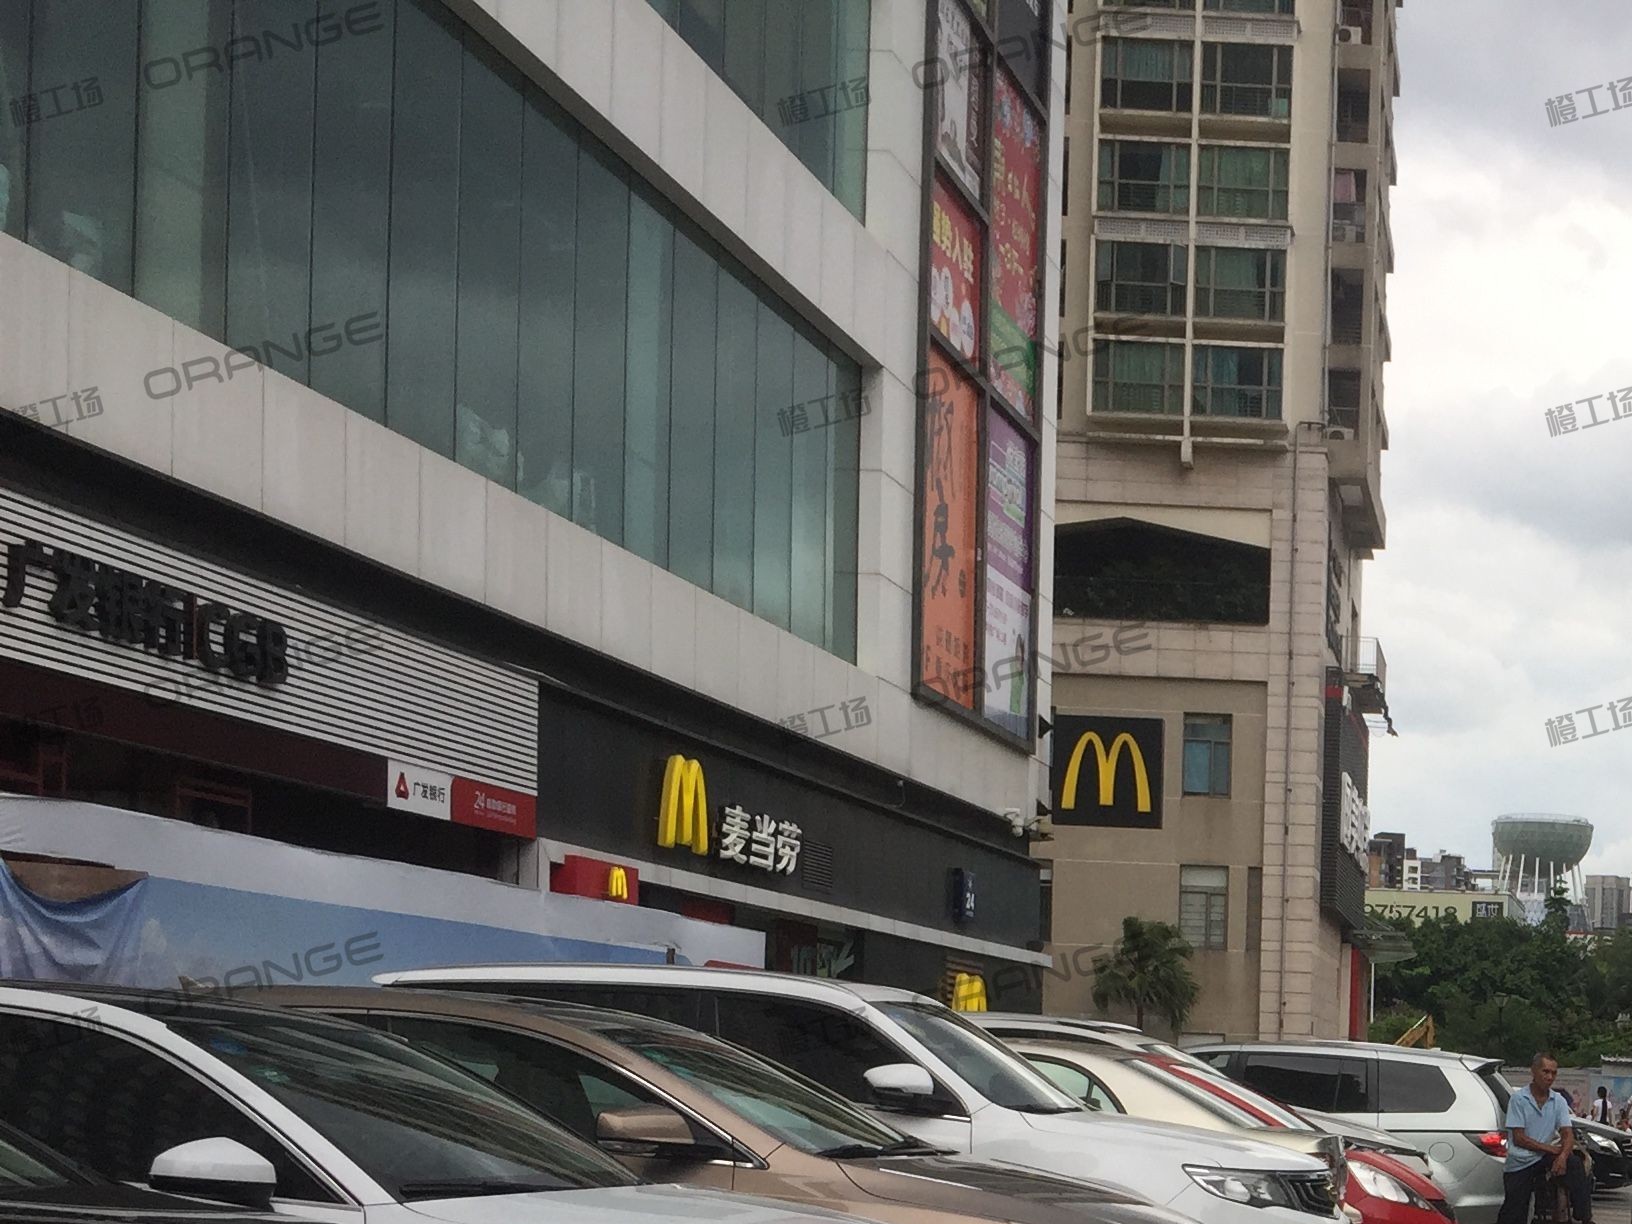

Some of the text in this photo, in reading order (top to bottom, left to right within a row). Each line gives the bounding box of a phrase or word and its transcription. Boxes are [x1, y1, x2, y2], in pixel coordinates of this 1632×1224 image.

[197, 601, 289, 684] CGB
[412, 780, 447, 804] 广发银行
[719, 804, 803, 876] 麦当劳
